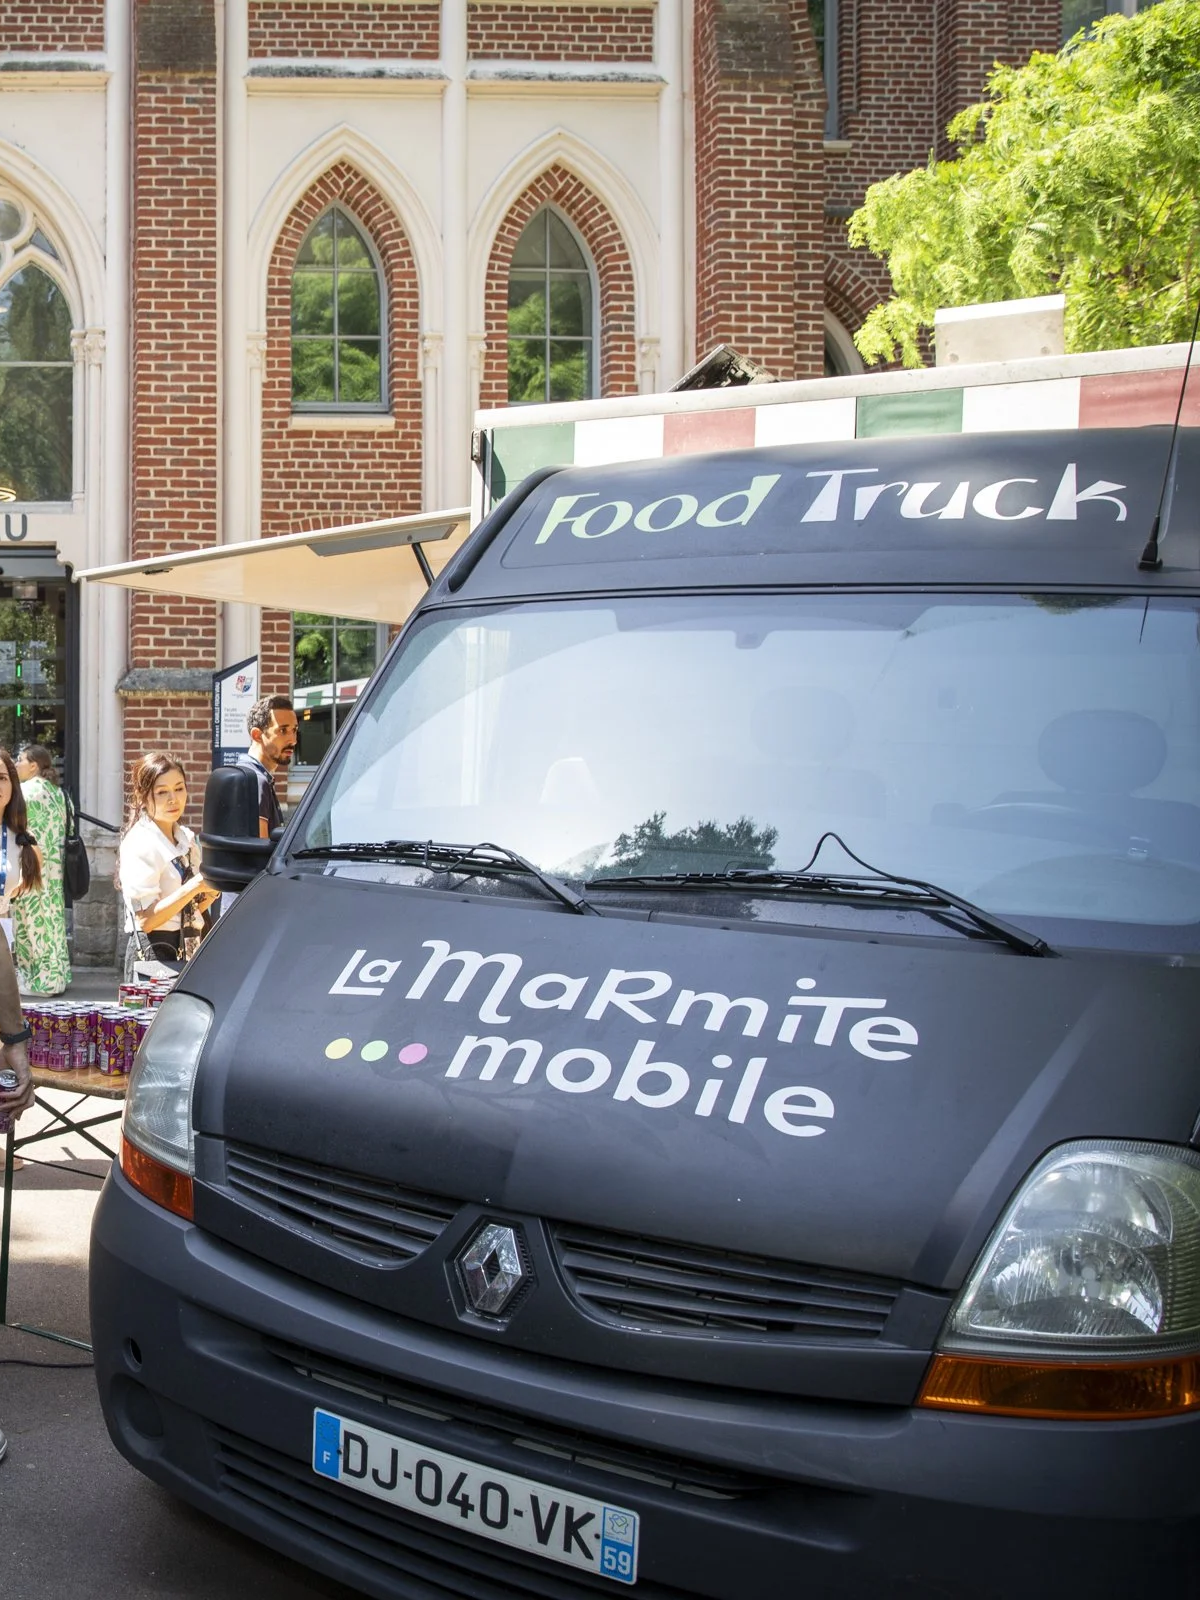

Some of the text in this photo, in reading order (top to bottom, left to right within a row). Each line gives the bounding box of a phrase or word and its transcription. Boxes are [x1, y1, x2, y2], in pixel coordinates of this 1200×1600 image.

[534, 463, 1128, 545] Food Truck
[328, 949, 402, 997] La
[444, 1034, 836, 1138] mobile
[323, 1450, 331, 1464] F
[342, 1429, 596, 1561] DJ-040-VK
[603, 1546, 632, 1575] 59
